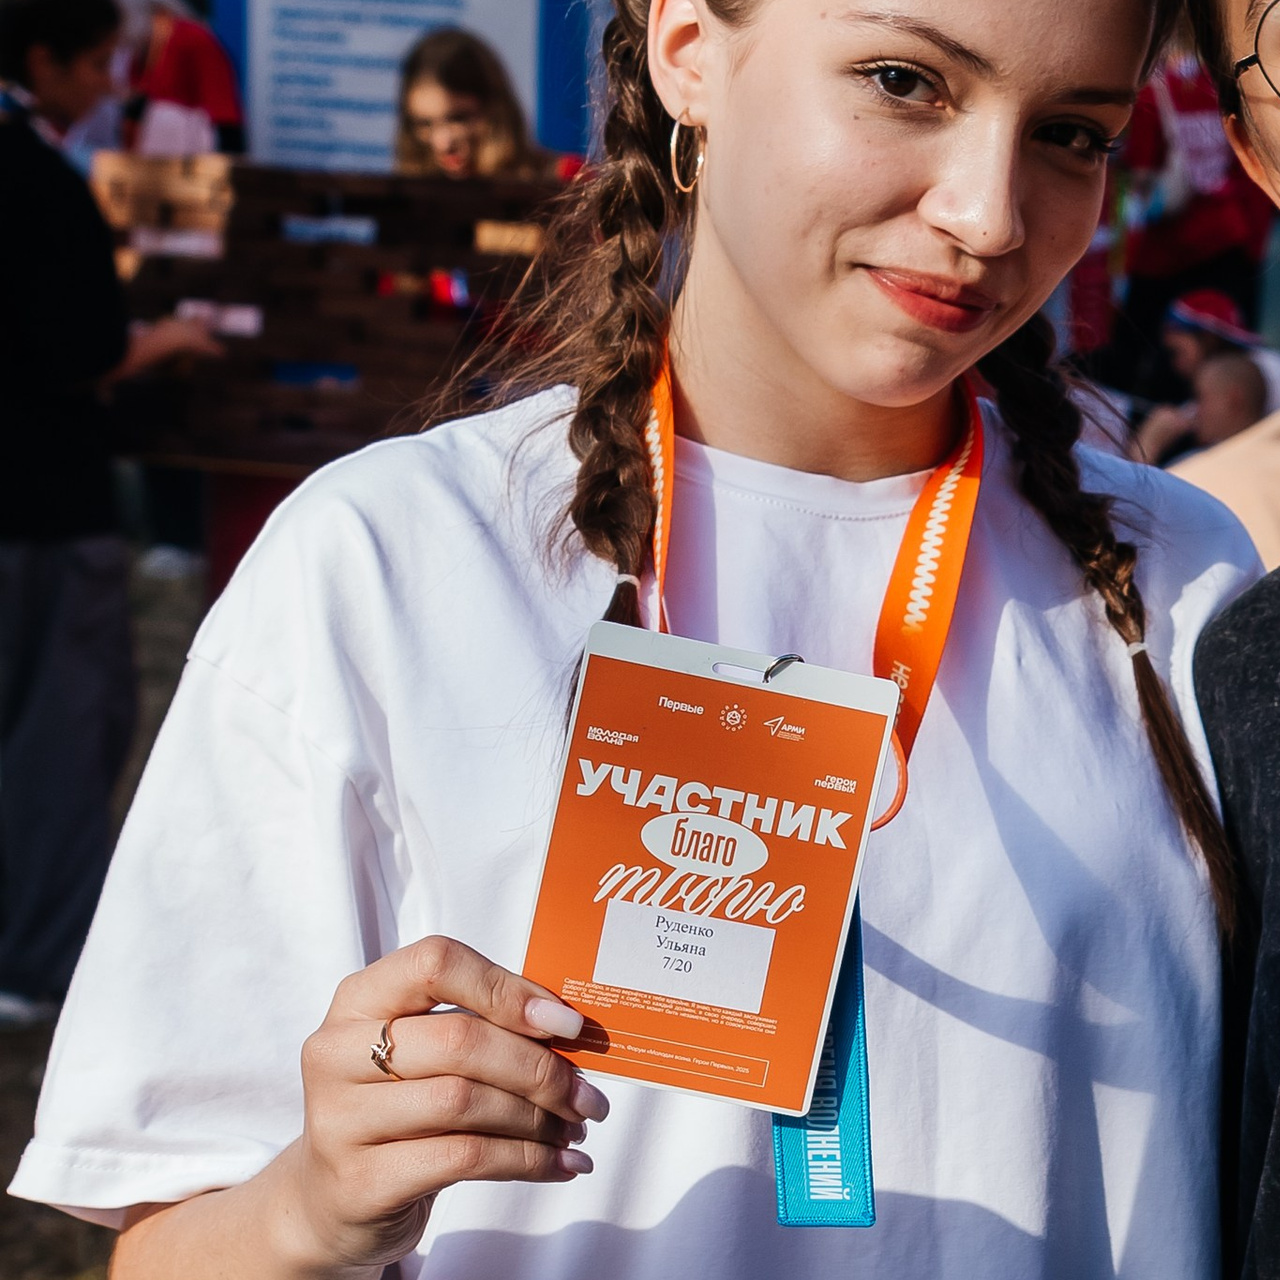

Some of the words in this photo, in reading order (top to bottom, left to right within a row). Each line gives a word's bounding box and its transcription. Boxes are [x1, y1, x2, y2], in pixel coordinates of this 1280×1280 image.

[657, 695, 705, 718] Первые
[587, 725, 639, 743] молодая
[780, 722, 806, 734] АРМИ
[586, 732, 623, 746] волна
[813, 778, 856, 794] первых
[824, 774, 857, 788] герои
[576, 759, 853, 850] УЧАСТНИК
[671, 819, 738, 867] благо
[654, 914, 715, 940] Руденко
[654, 935, 707, 957] Ульяна
[661, 955, 693, 974] 7/20
[806, 1097, 850, 1200] ВОЛНЕНИЙ
